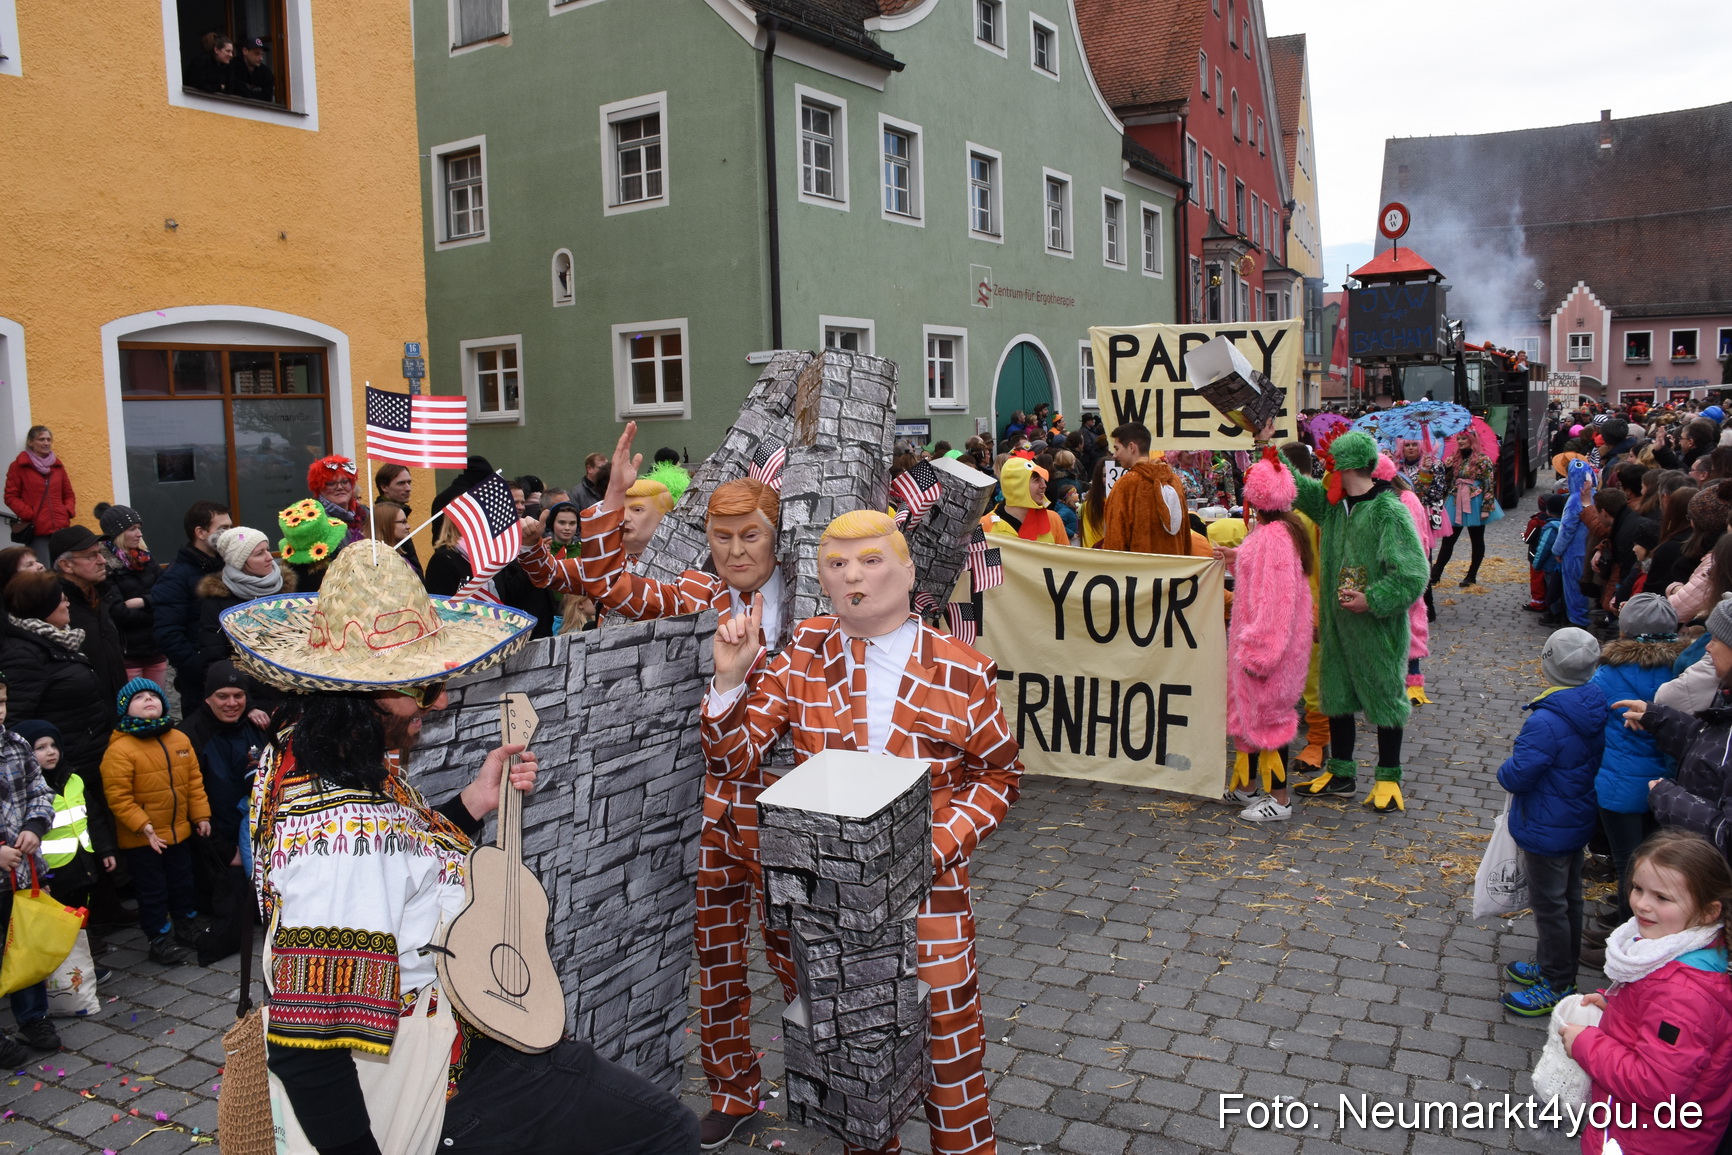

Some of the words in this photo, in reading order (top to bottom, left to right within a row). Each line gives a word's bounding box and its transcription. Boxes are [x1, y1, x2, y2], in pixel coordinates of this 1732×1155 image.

[993, 283, 1024, 300] Zentrum
[1025, 288, 1035, 301] für
[1036, 290, 1075, 308] Ergotherapie
[1359, 287, 1429, 312] JVW
[409, 344, 417, 353] 16
[1352, 324, 1434, 354] BACHAM
[1655, 376, 1710, 388] Hutter
[1043, 567, 1199, 649] YOUR
